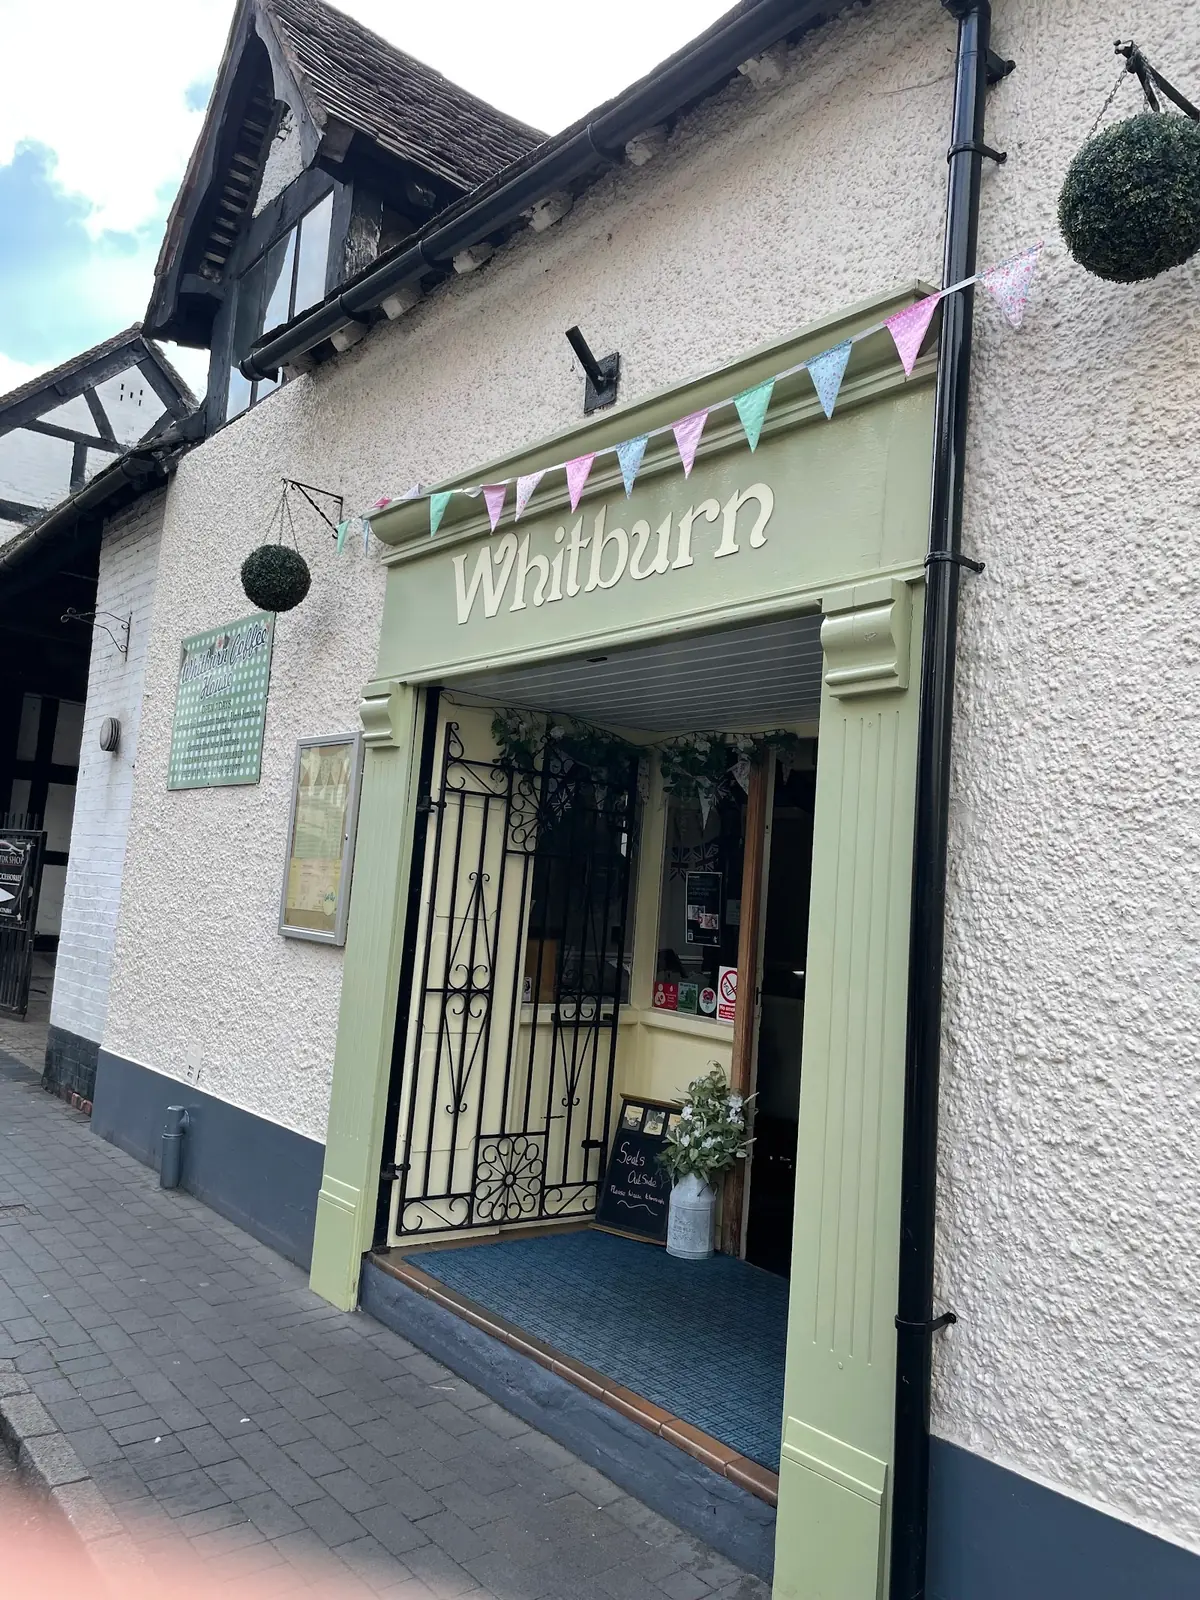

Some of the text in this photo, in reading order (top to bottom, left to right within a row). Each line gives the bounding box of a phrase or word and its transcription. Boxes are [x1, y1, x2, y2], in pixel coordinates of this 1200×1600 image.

[452, 482, 775, 625] Whitburn
[229, 624, 267, 667] Coffee
[200, 672, 233, 700] House
[218, 699, 231, 710] DAYS
[616, 1141, 645, 1167] Seats
